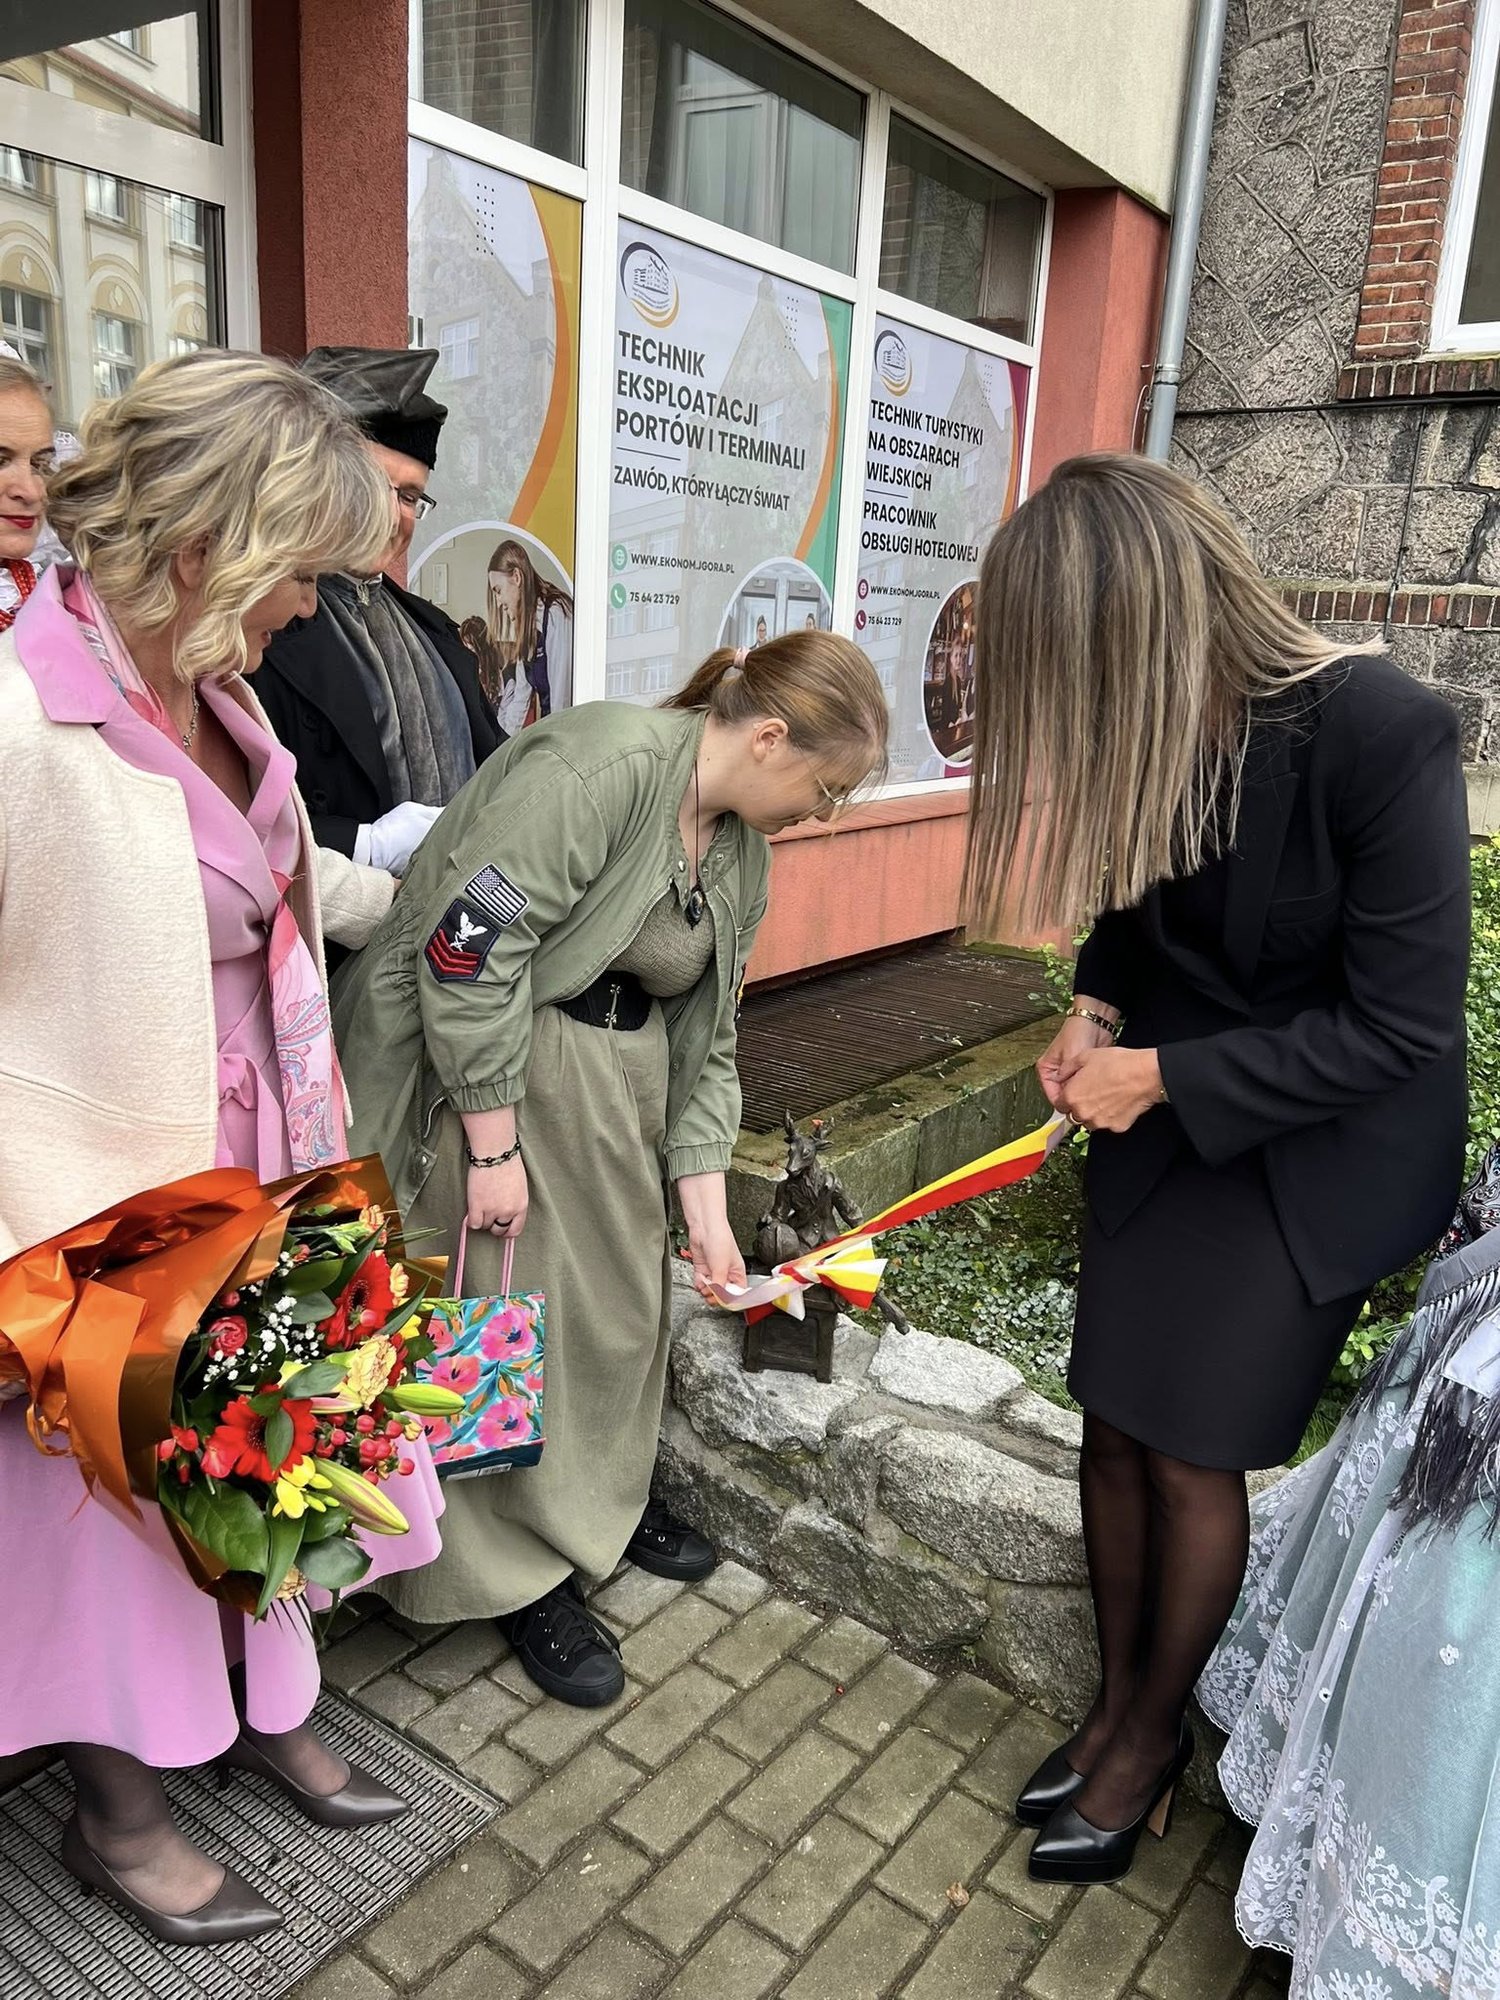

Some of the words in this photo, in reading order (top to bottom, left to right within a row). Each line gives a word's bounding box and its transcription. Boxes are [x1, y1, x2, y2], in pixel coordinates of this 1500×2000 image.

[618, 330, 706, 378] TECHNIK
[617, 369, 759, 427] EKSPLOATACJI
[616, 408, 705, 450] PORTÓW
[708, 428, 714, 452] I
[718, 430, 806, 471] TERMINALI
[871, 399, 923, 431] TECHNIK
[925, 414, 984, 446] TURYSTYKI
[868, 430, 886, 452] NA
[889, 436, 960, 469] OBSZARACH
[613, 465, 670, 495] ZAWÓD,
[672, 474, 714, 499] KTÓRY
[715, 483, 754, 507] ŁĄCZY
[754, 485, 790, 511] ŚWIAT
[867, 460, 932, 491] WIEJSKICH
[863, 501, 938, 530] PRACOWNIK
[630, 553, 735, 574] WWW.EKONOM.JGORA.PL
[861, 531, 912, 555] OBSŁUGI
[914, 538, 979, 563] HOTELOWEJ
[630, 591, 640, 602] 75
[641, 592, 652, 603] 64
[653, 593, 664, 604] 23
[665, 594, 680, 605] 729
[868, 615, 875, 625] 75
[876, 616, 883, 625] 64
[884, 616, 891, 626] 23
[892, 617, 902, 626] 729
